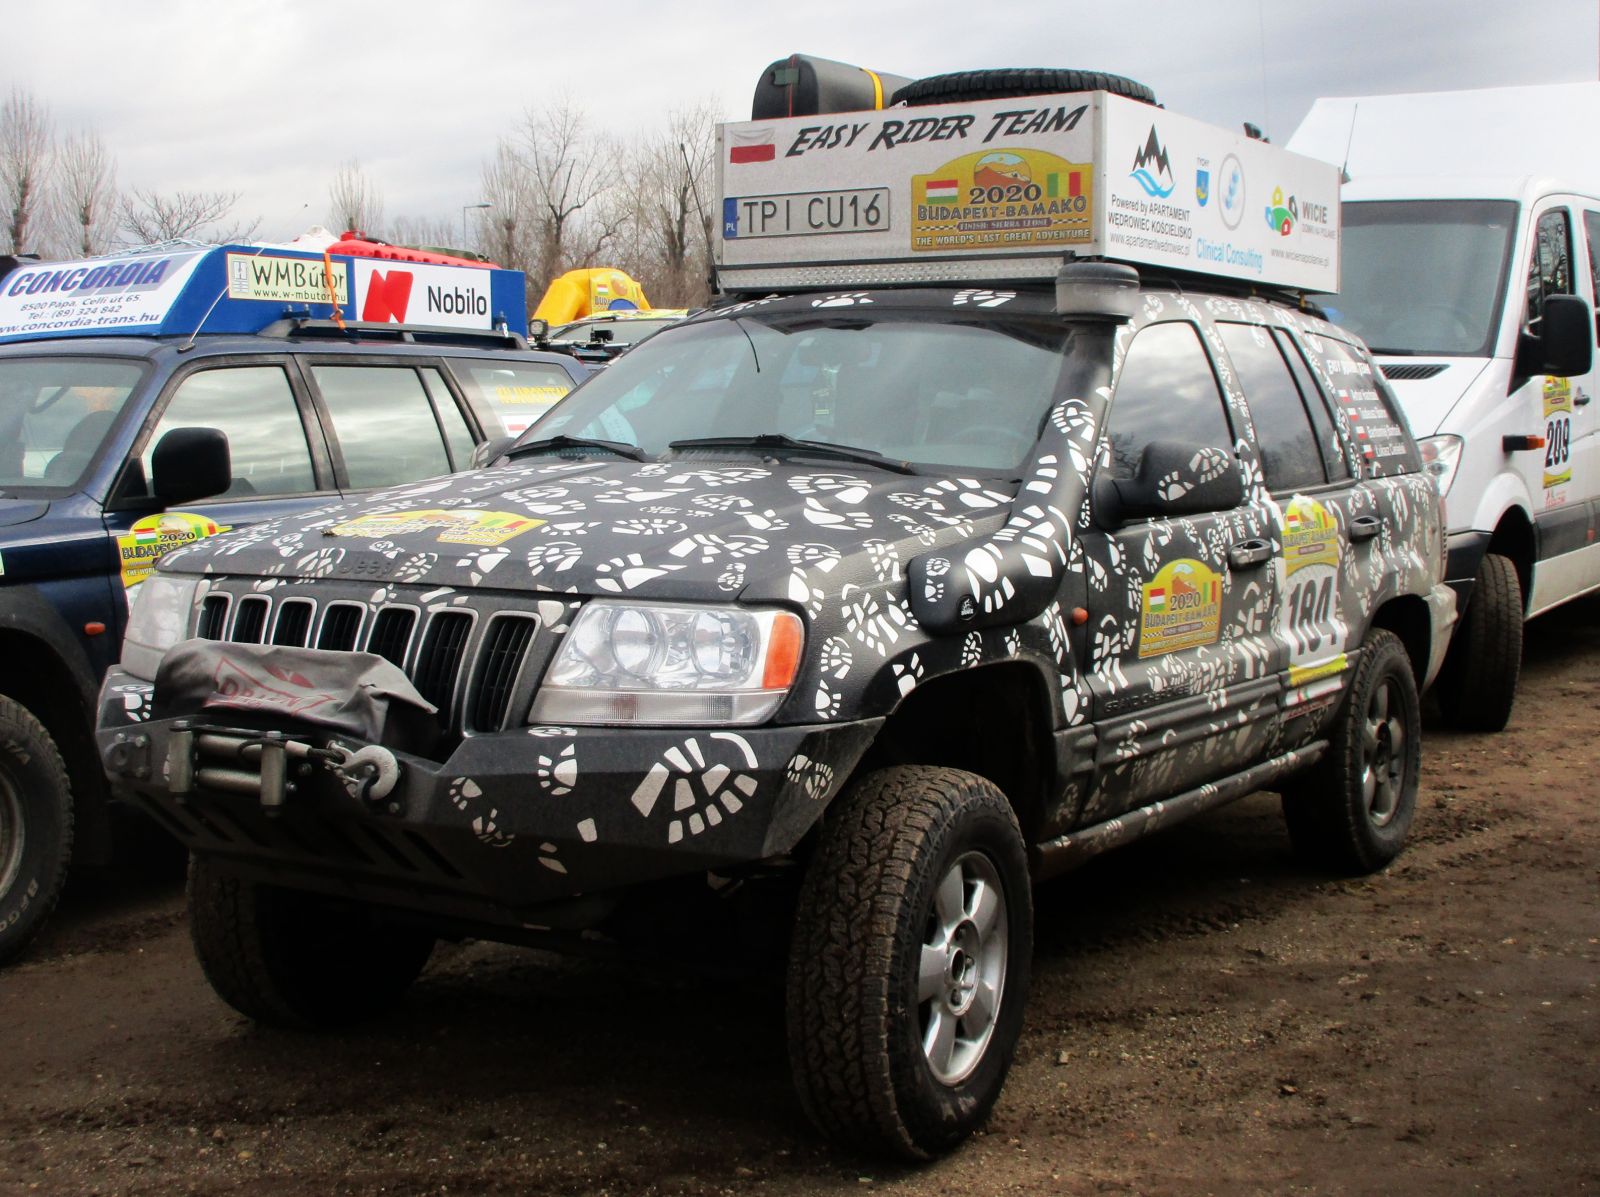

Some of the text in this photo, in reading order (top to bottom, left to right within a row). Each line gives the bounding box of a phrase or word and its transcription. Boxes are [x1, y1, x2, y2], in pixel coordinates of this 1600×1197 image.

[785, 105, 1089, 157] EASY RIDER TEAM
[969, 184, 1042, 205] 2020
[743, 193, 880, 233] TPI CU16
[917, 195, 1087, 221] BUDAPEST-BAMAKO
[1111, 194, 1190, 222] Powered by APARTAMENT
[1302, 201, 1328, 224] WICIE
[725, 223, 736, 232] PL
[916, 229, 1089, 246] THE WORLD'S LAST GREAT ADVENTURE
[1197, 238, 1263, 274] Clinical Consulting
[8, 260, 171, 297] CONCORDIA
[20, 302, 47, 312] 8500
[82, 295, 107, 306] Celli
[51, 309, 74, 319] (89)
[77, 307, 98, 315] 324
[100, 305, 122, 314] 842
[428, 286, 487, 315] Nobilo
[1545, 418, 1569, 468] 209
[160, 532, 195, 542] 2020
[1170, 592, 1201, 611] 2020
[1289, 576, 1337, 656] 184
